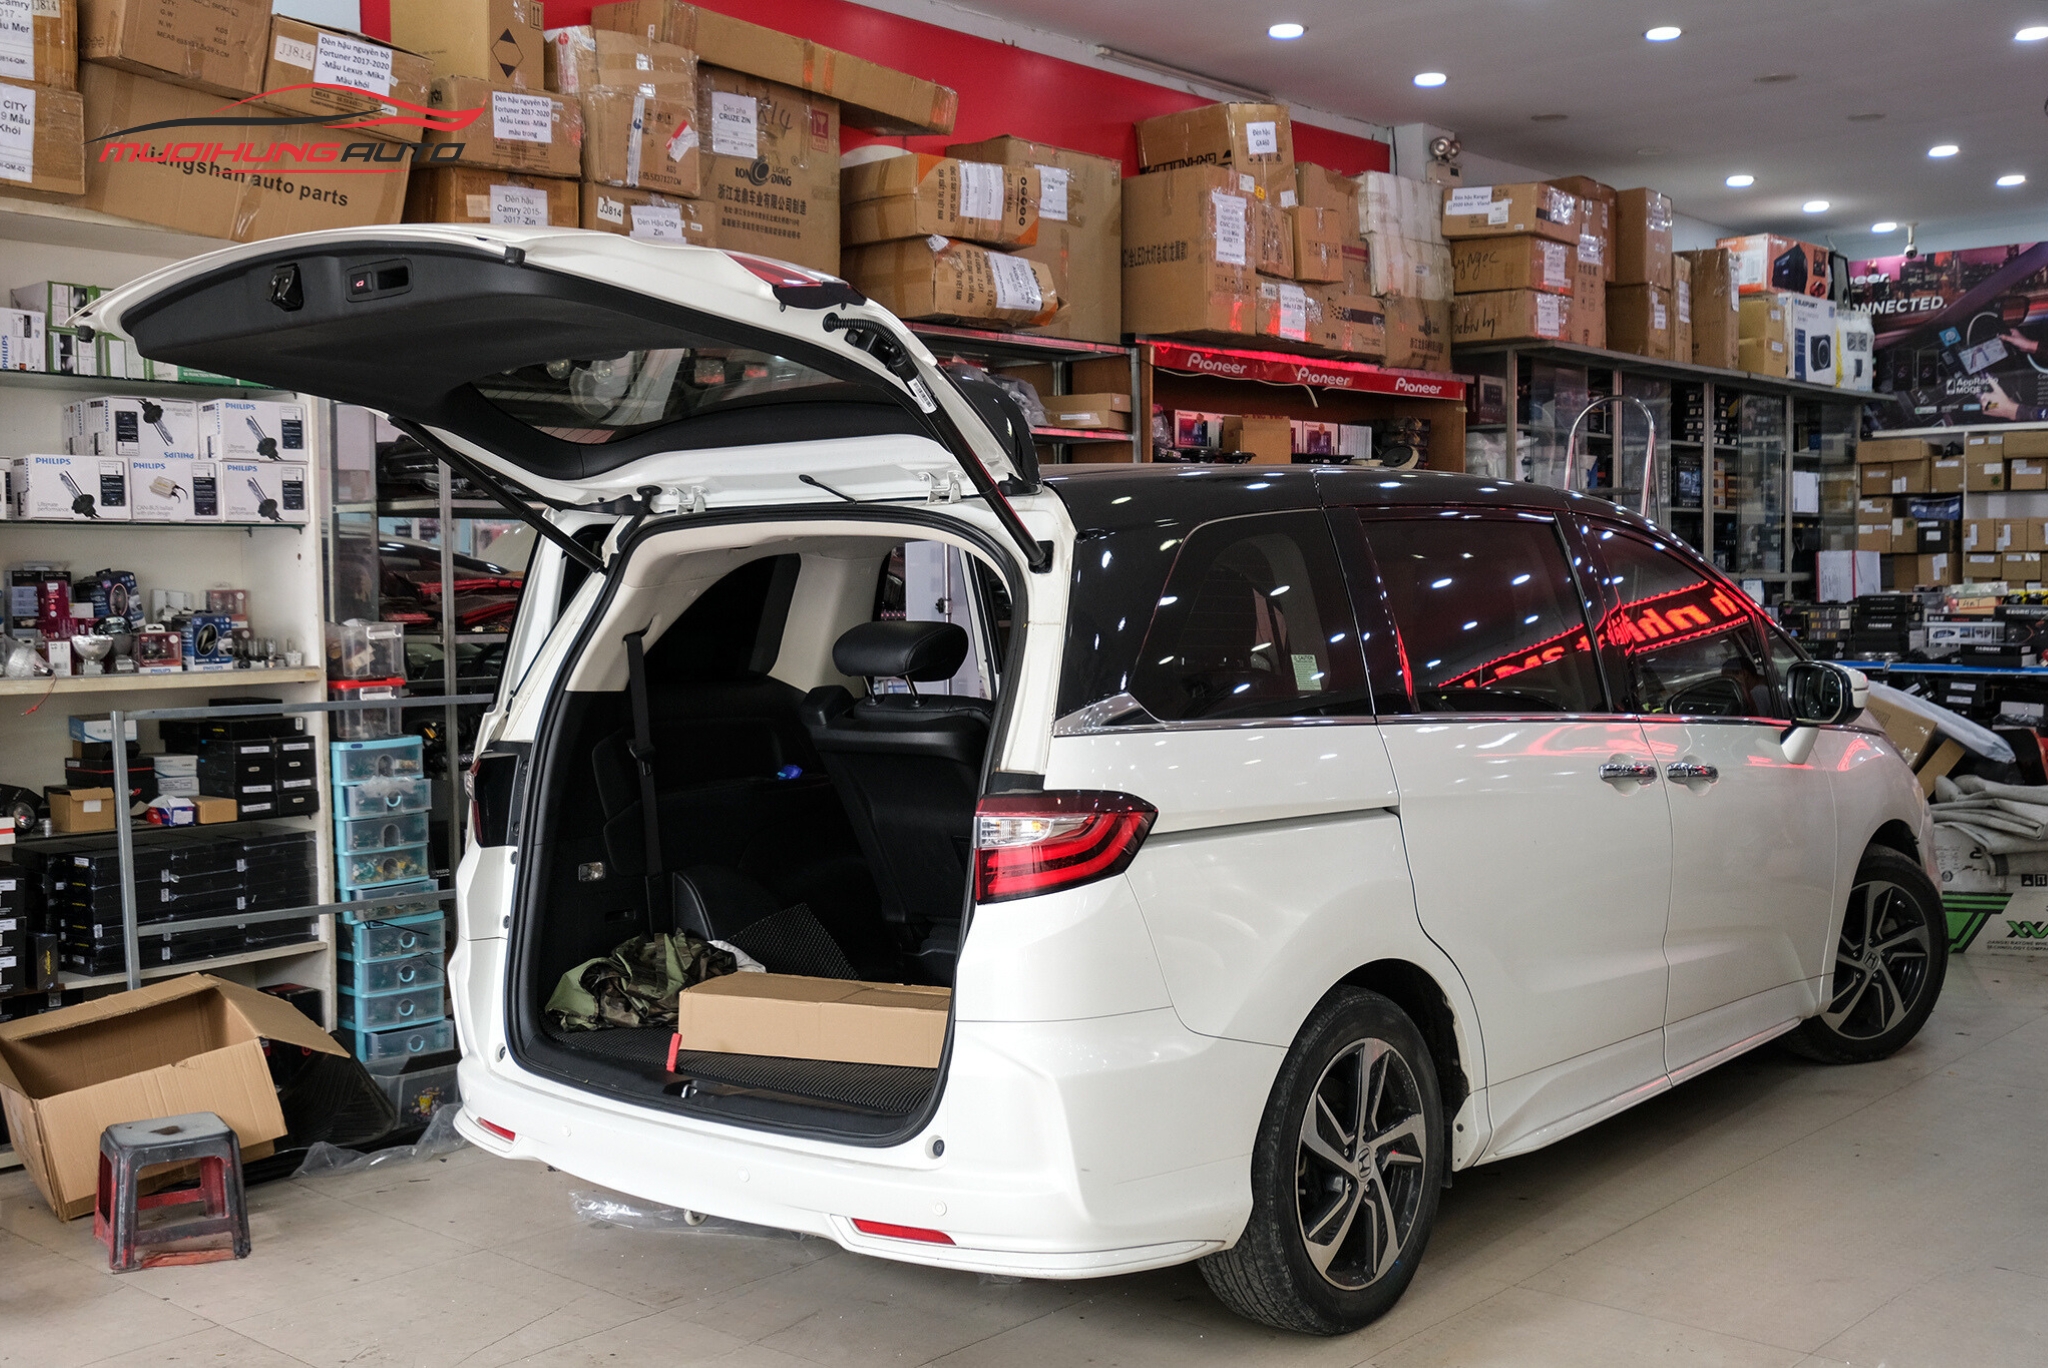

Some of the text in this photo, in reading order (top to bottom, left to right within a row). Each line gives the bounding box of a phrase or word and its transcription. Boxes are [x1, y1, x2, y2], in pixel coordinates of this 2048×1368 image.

[12, 22, 30, 33] Mer
[279, 44, 312, 62] JJ814
[321, 37, 390, 60] Đèn hậu nguyên bộ
[319, 48, 390, 71] Fortuner 2017-2020
[343, 66, 363, 76] Lexus
[353, 78, 370, 89] khói
[495, 94, 507, 102] Đèn
[507, 96, 519, 104] hậu
[4, 100, 27, 112] CITY
[494, 105, 550, 117] Fortuner 2017-2020
[514, 118, 530, 126] Lexus
[718, 112, 751, 125] CRUZE ZIN
[522, 130, 538, 138] trong
[772, 166, 789, 175] LIGHT
[251, 174, 295, 195] auto
[299, 183, 349, 207] parts
[505, 194, 520, 203] Đèn
[497, 204, 541, 216] Camry 2015-
[503, 215, 520, 224] 2017
[664, 220, 677, 229] City
[653, 228, 664, 236] Zin
[1, 335, 9, 370] PHILIPS
[1186, 351, 1247, 375] Pioneer
[1296, 366, 1350, 387] Pioneer
[1394, 377, 1442, 395] Pioneer
[1956, 377, 1999, 387] AppRadio
[1955, 385, 1981, 395] MODE
[225, 402, 256, 411] PHILIPS
[163, 451, 195, 459] PHILIPS
[35, 457, 72, 466] PHILIPS
[133, 462, 166, 470] PHILIPS
[227, 464, 258, 472] PHILIPS
